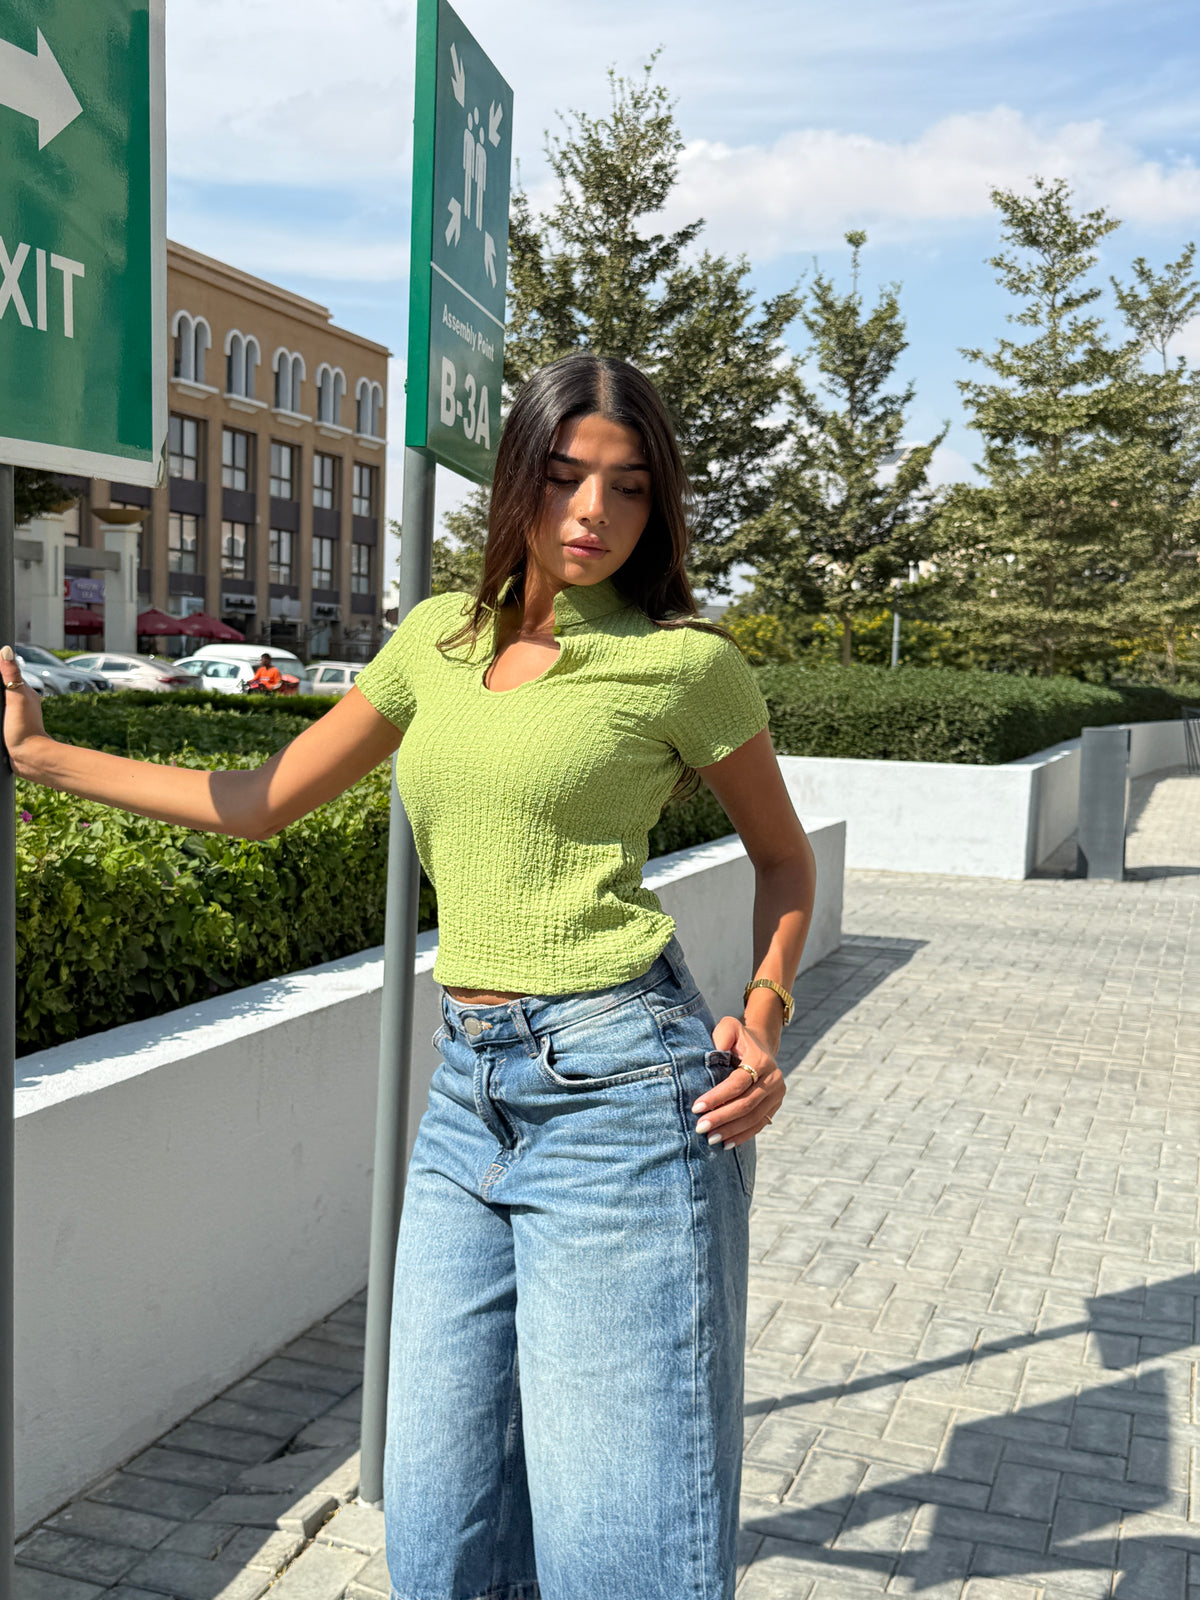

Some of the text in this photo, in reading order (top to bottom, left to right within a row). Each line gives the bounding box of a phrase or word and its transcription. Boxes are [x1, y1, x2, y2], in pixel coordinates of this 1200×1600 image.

[0, 235, 85, 339] XIT
[442, 303, 494, 362] Assembly Point
[440, 356, 490, 450] B-3A
